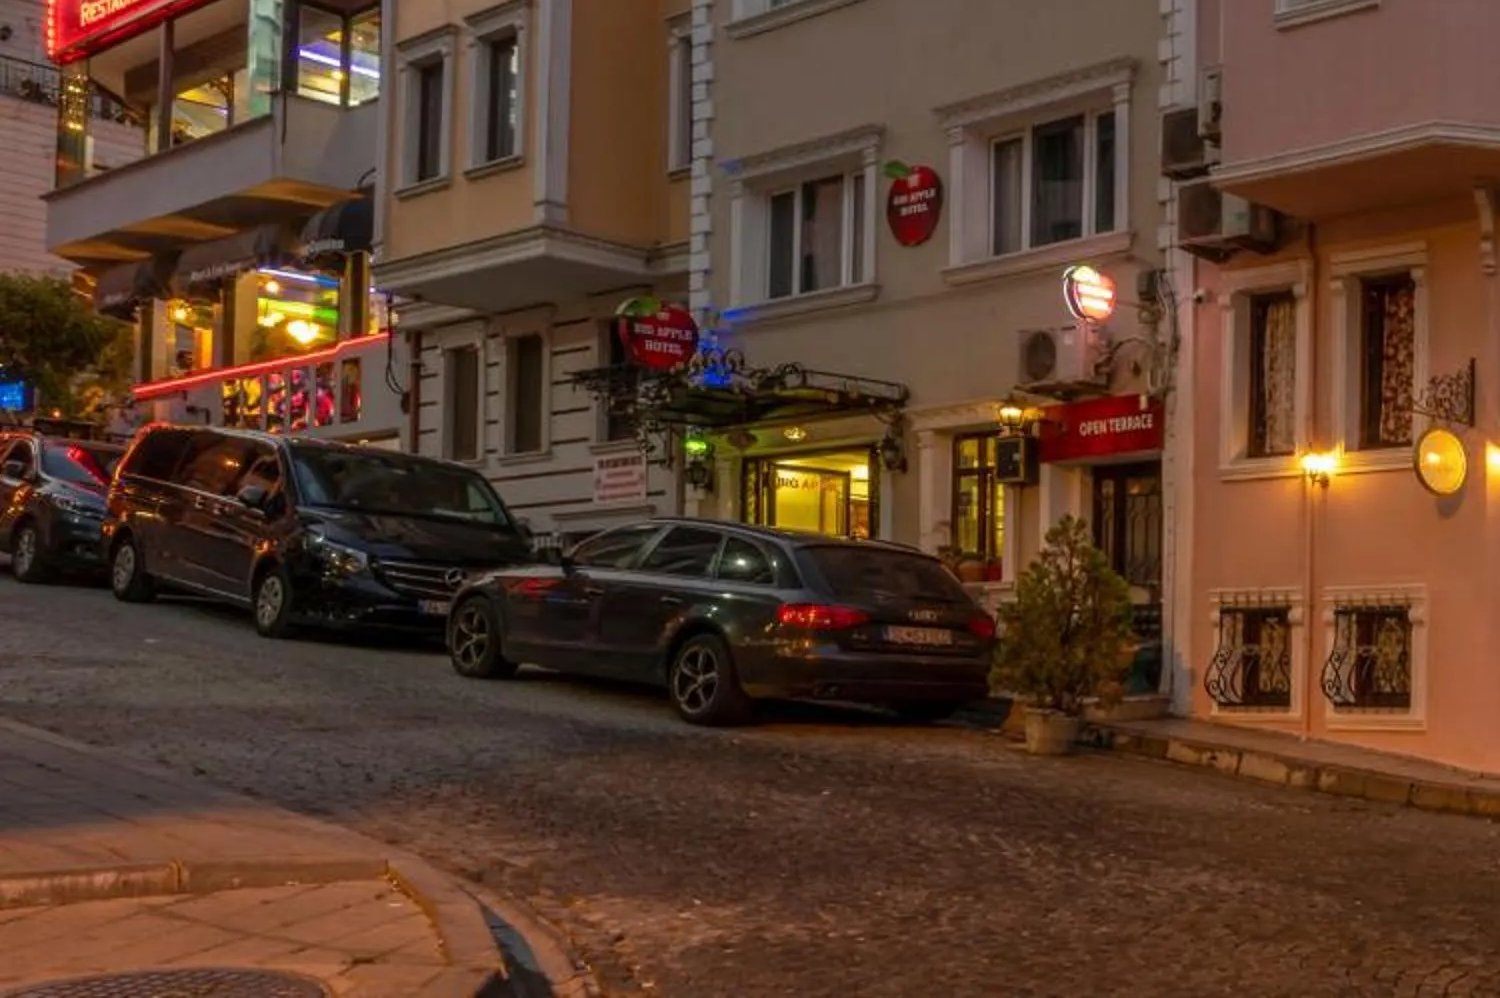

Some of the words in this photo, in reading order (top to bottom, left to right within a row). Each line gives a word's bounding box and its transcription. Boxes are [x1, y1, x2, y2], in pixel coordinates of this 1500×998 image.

[634, 323, 654, 335] BIG
[657, 326, 693, 340] APPLE
[645, 339, 684, 355] HOTEL
[1079, 420, 1108, 437] OPEN
[1110, 413, 1153, 433] TERRACE
